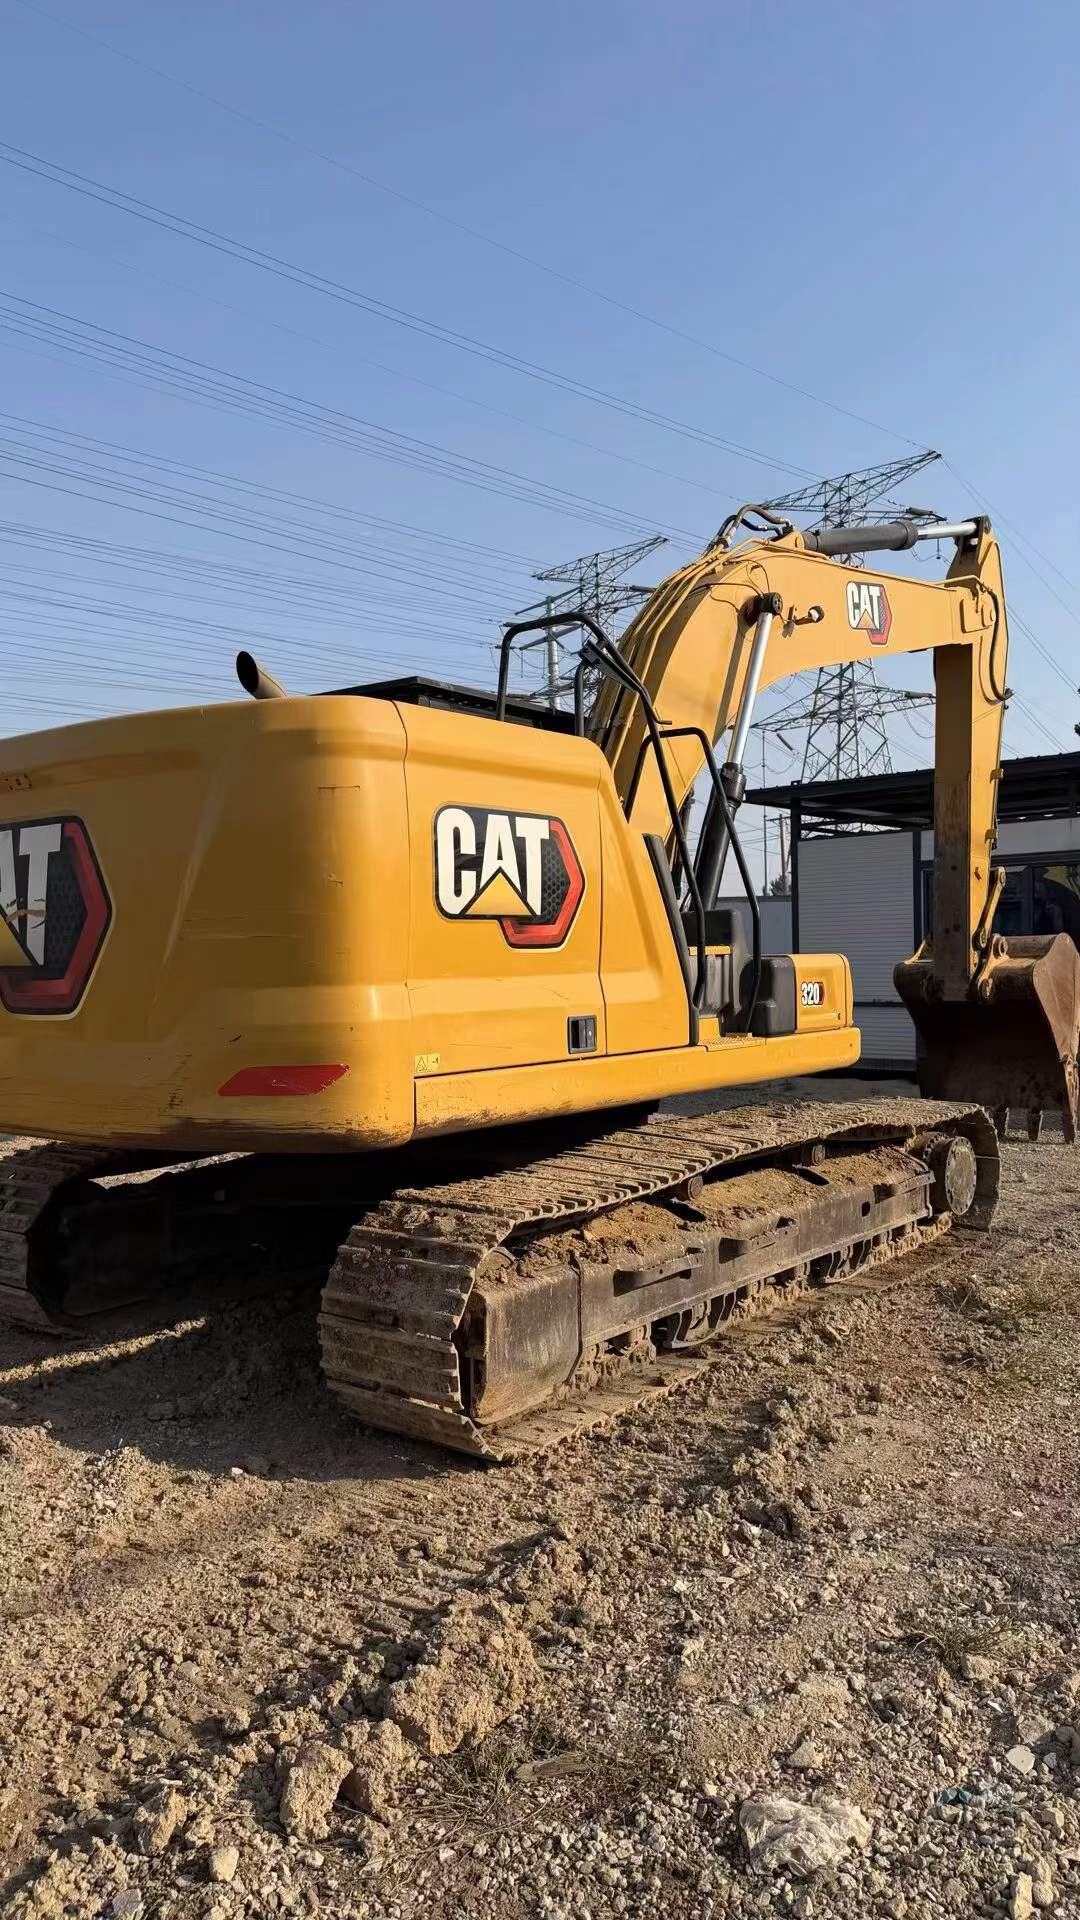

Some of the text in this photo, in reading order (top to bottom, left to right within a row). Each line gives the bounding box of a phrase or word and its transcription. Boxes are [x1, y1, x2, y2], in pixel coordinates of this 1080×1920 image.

[847, 582, 880, 629] CAT
[437, 808, 550, 915] CAT
[801, 982, 820, 1005] 320
